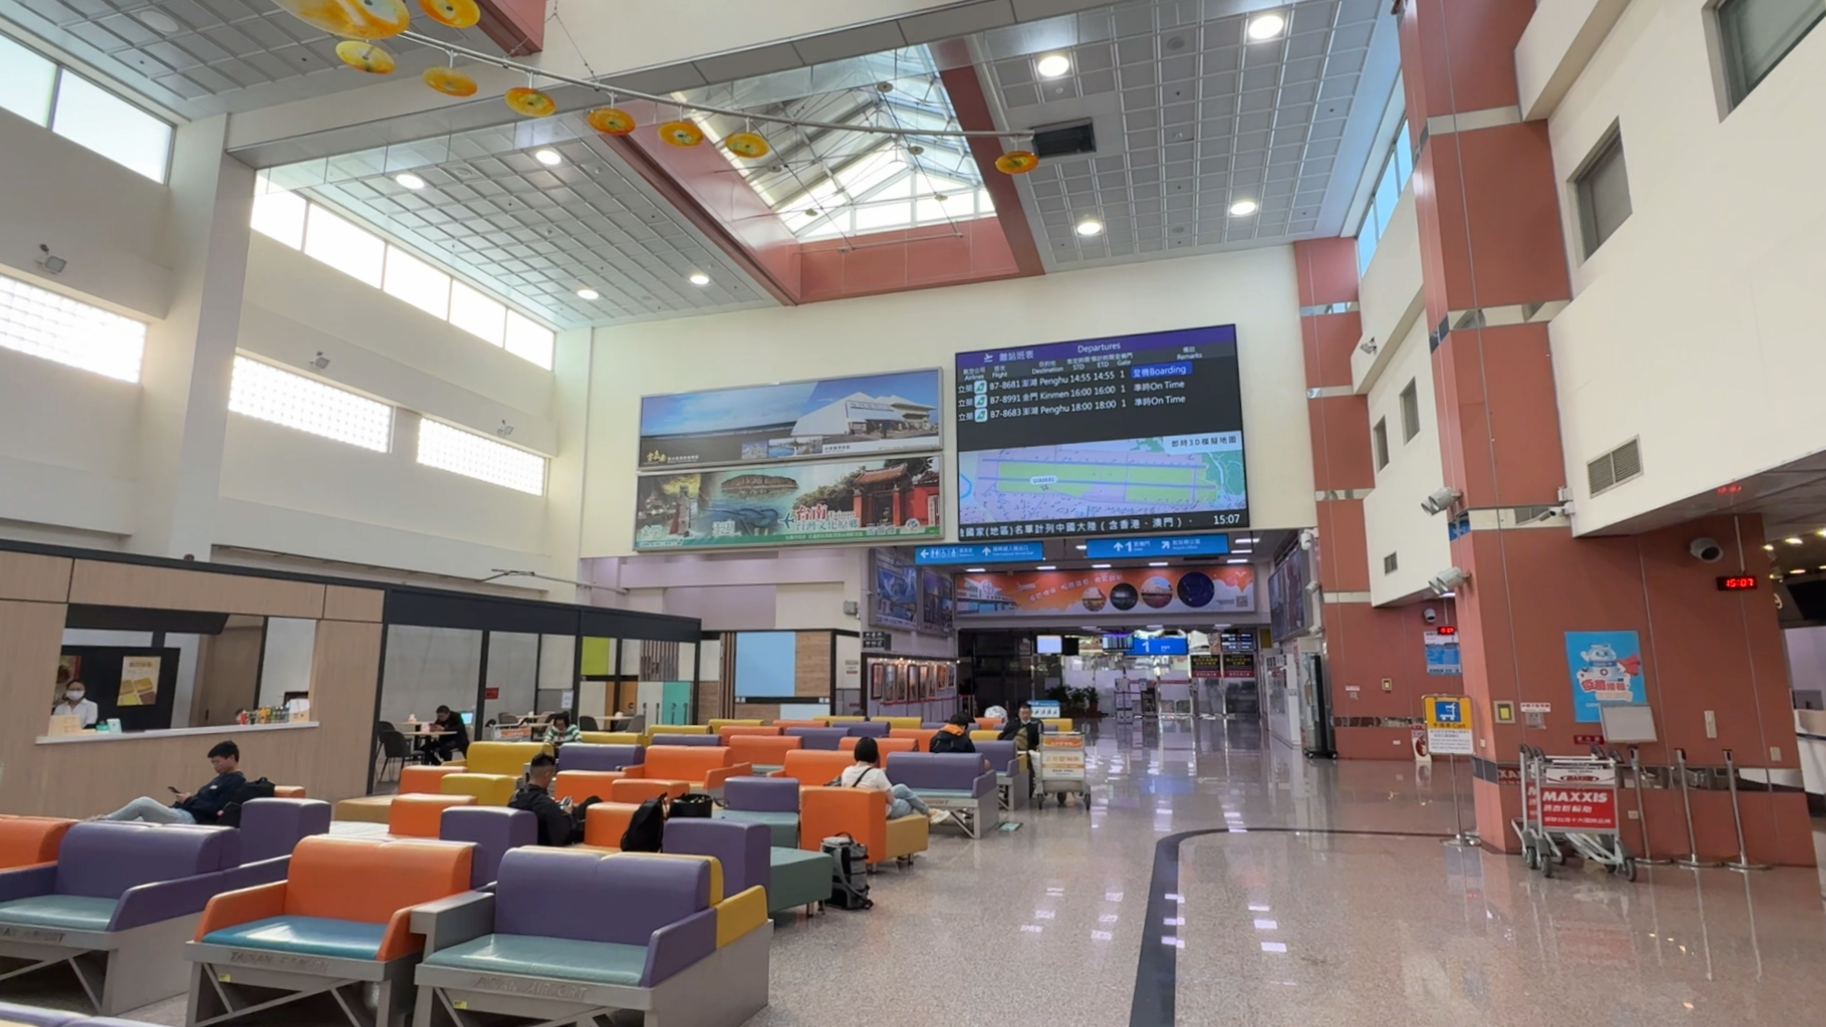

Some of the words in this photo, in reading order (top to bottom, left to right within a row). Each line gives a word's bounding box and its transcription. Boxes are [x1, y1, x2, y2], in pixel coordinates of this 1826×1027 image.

[1077, 342, 1121, 354] Departures
[1177, 353, 1203, 361] Remarks
[992, 371, 1008, 380] Flight
[1032, 366, 1064, 375] Destination
[989, 380, 1020, 391] B7-8681
[1022, 379, 1038, 388] 澎湖
[1040, 376, 1069, 387] Penghu
[1070, 373, 1091, 383] 14:55
[1093, 371, 1115, 380] 14:55
[1120, 370, 1125, 379] 1
[990, 394, 1021, 405] B7-8991
[1022, 392, 1039, 402] 金門
[1040, 390, 1070, 400] Kinmen
[1071, 387, 1092, 397] 16:00
[1094, 386, 1116, 396] 16:00
[1121, 385, 1126, 393] 1
[1164, 380, 1185, 390] Time
[990, 408, 1021, 418] B7-8683
[1023, 406, 1039, 416] 澎湖
[1040, 404, 1070, 415] Penghu
[1072, 402, 1093, 412] 18:00
[1095, 400, 1117, 410] 18:00
[1122, 399, 1127, 408] 1
[1165, 395, 1186, 405] Time
[1171, 435, 1237, 448] 即時3D模擬地圖
[797, 504, 828, 521] 台南
[1213, 513, 1241, 526] 15:07
[1124, 541, 1132, 552] 1
[1726, 578, 1754, 588] 15:07
[1142, 641, 1150, 653] 1
[1542, 791, 1608, 804] MAXXIS
